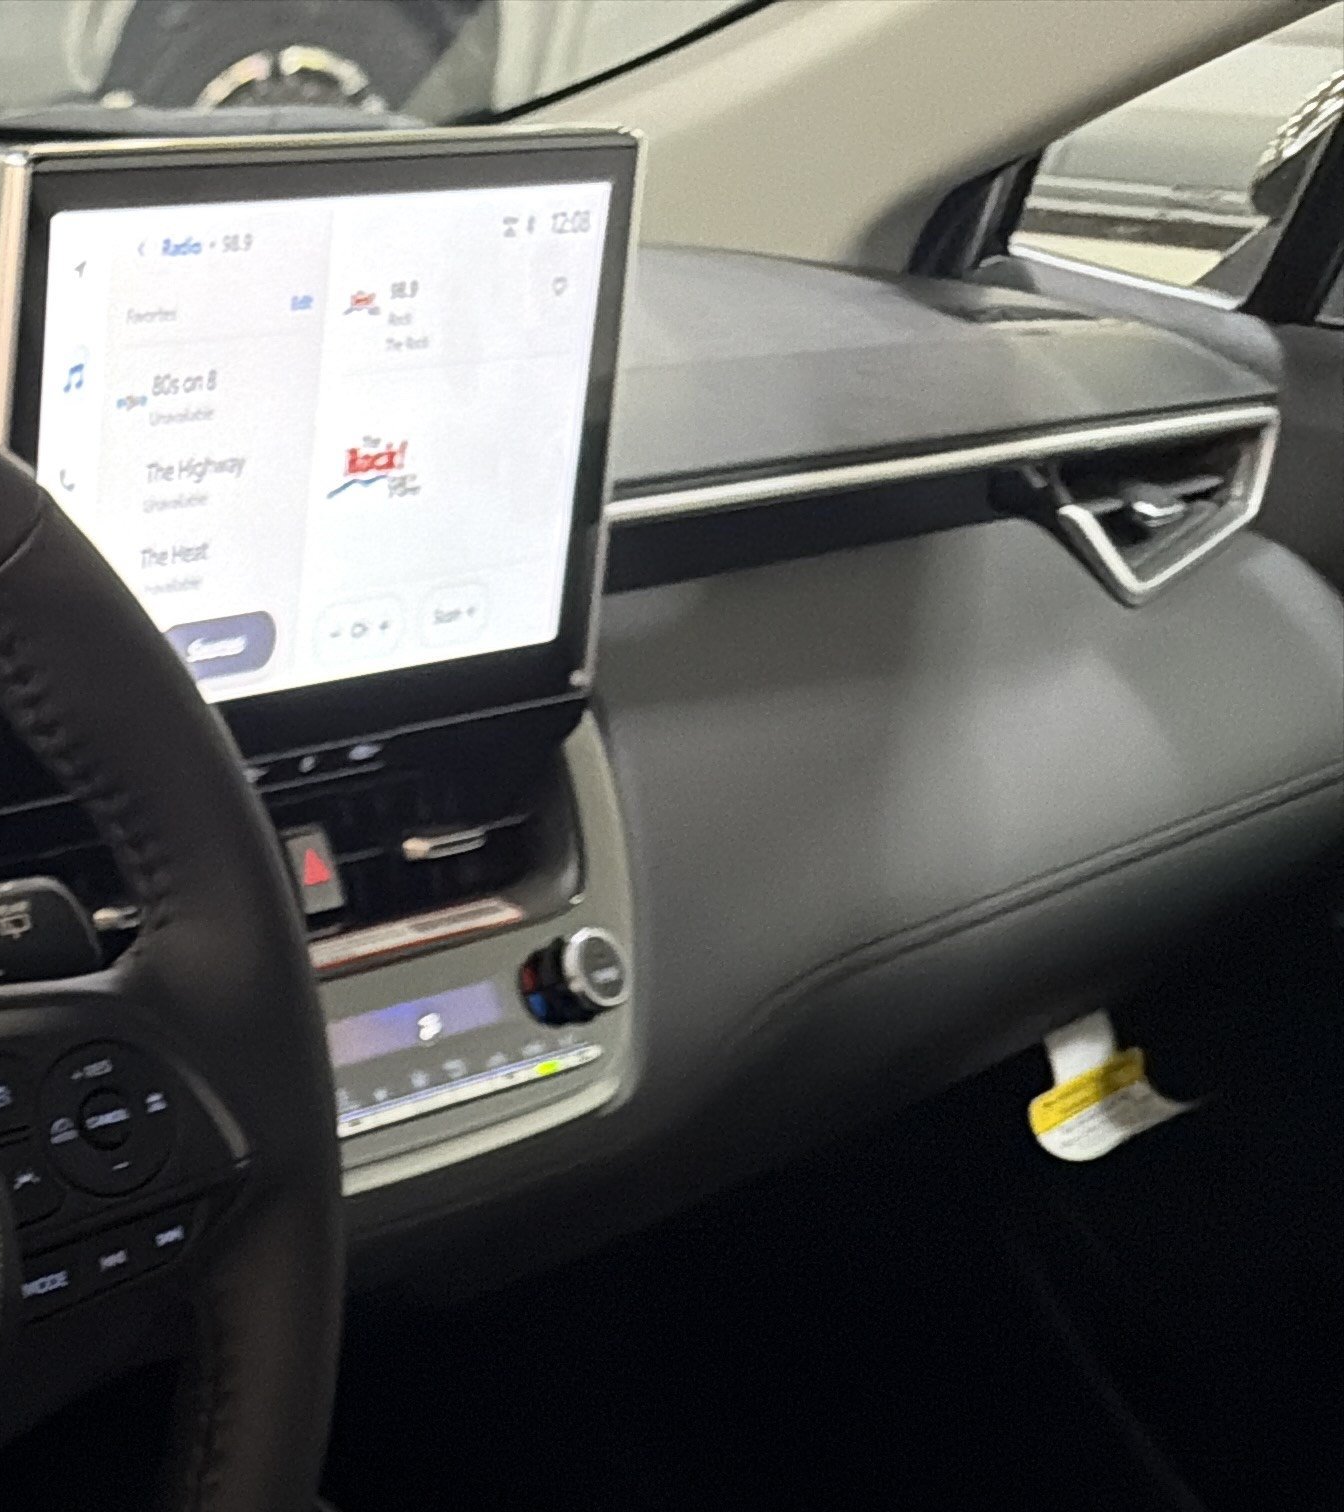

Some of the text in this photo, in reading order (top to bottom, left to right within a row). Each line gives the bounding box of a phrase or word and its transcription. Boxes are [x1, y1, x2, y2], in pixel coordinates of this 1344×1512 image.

[162, 236, 202, 257] Radio
[183, 376, 204, 394] on
[146, 457, 246, 484] The Highway
[141, 547, 169, 569] The
